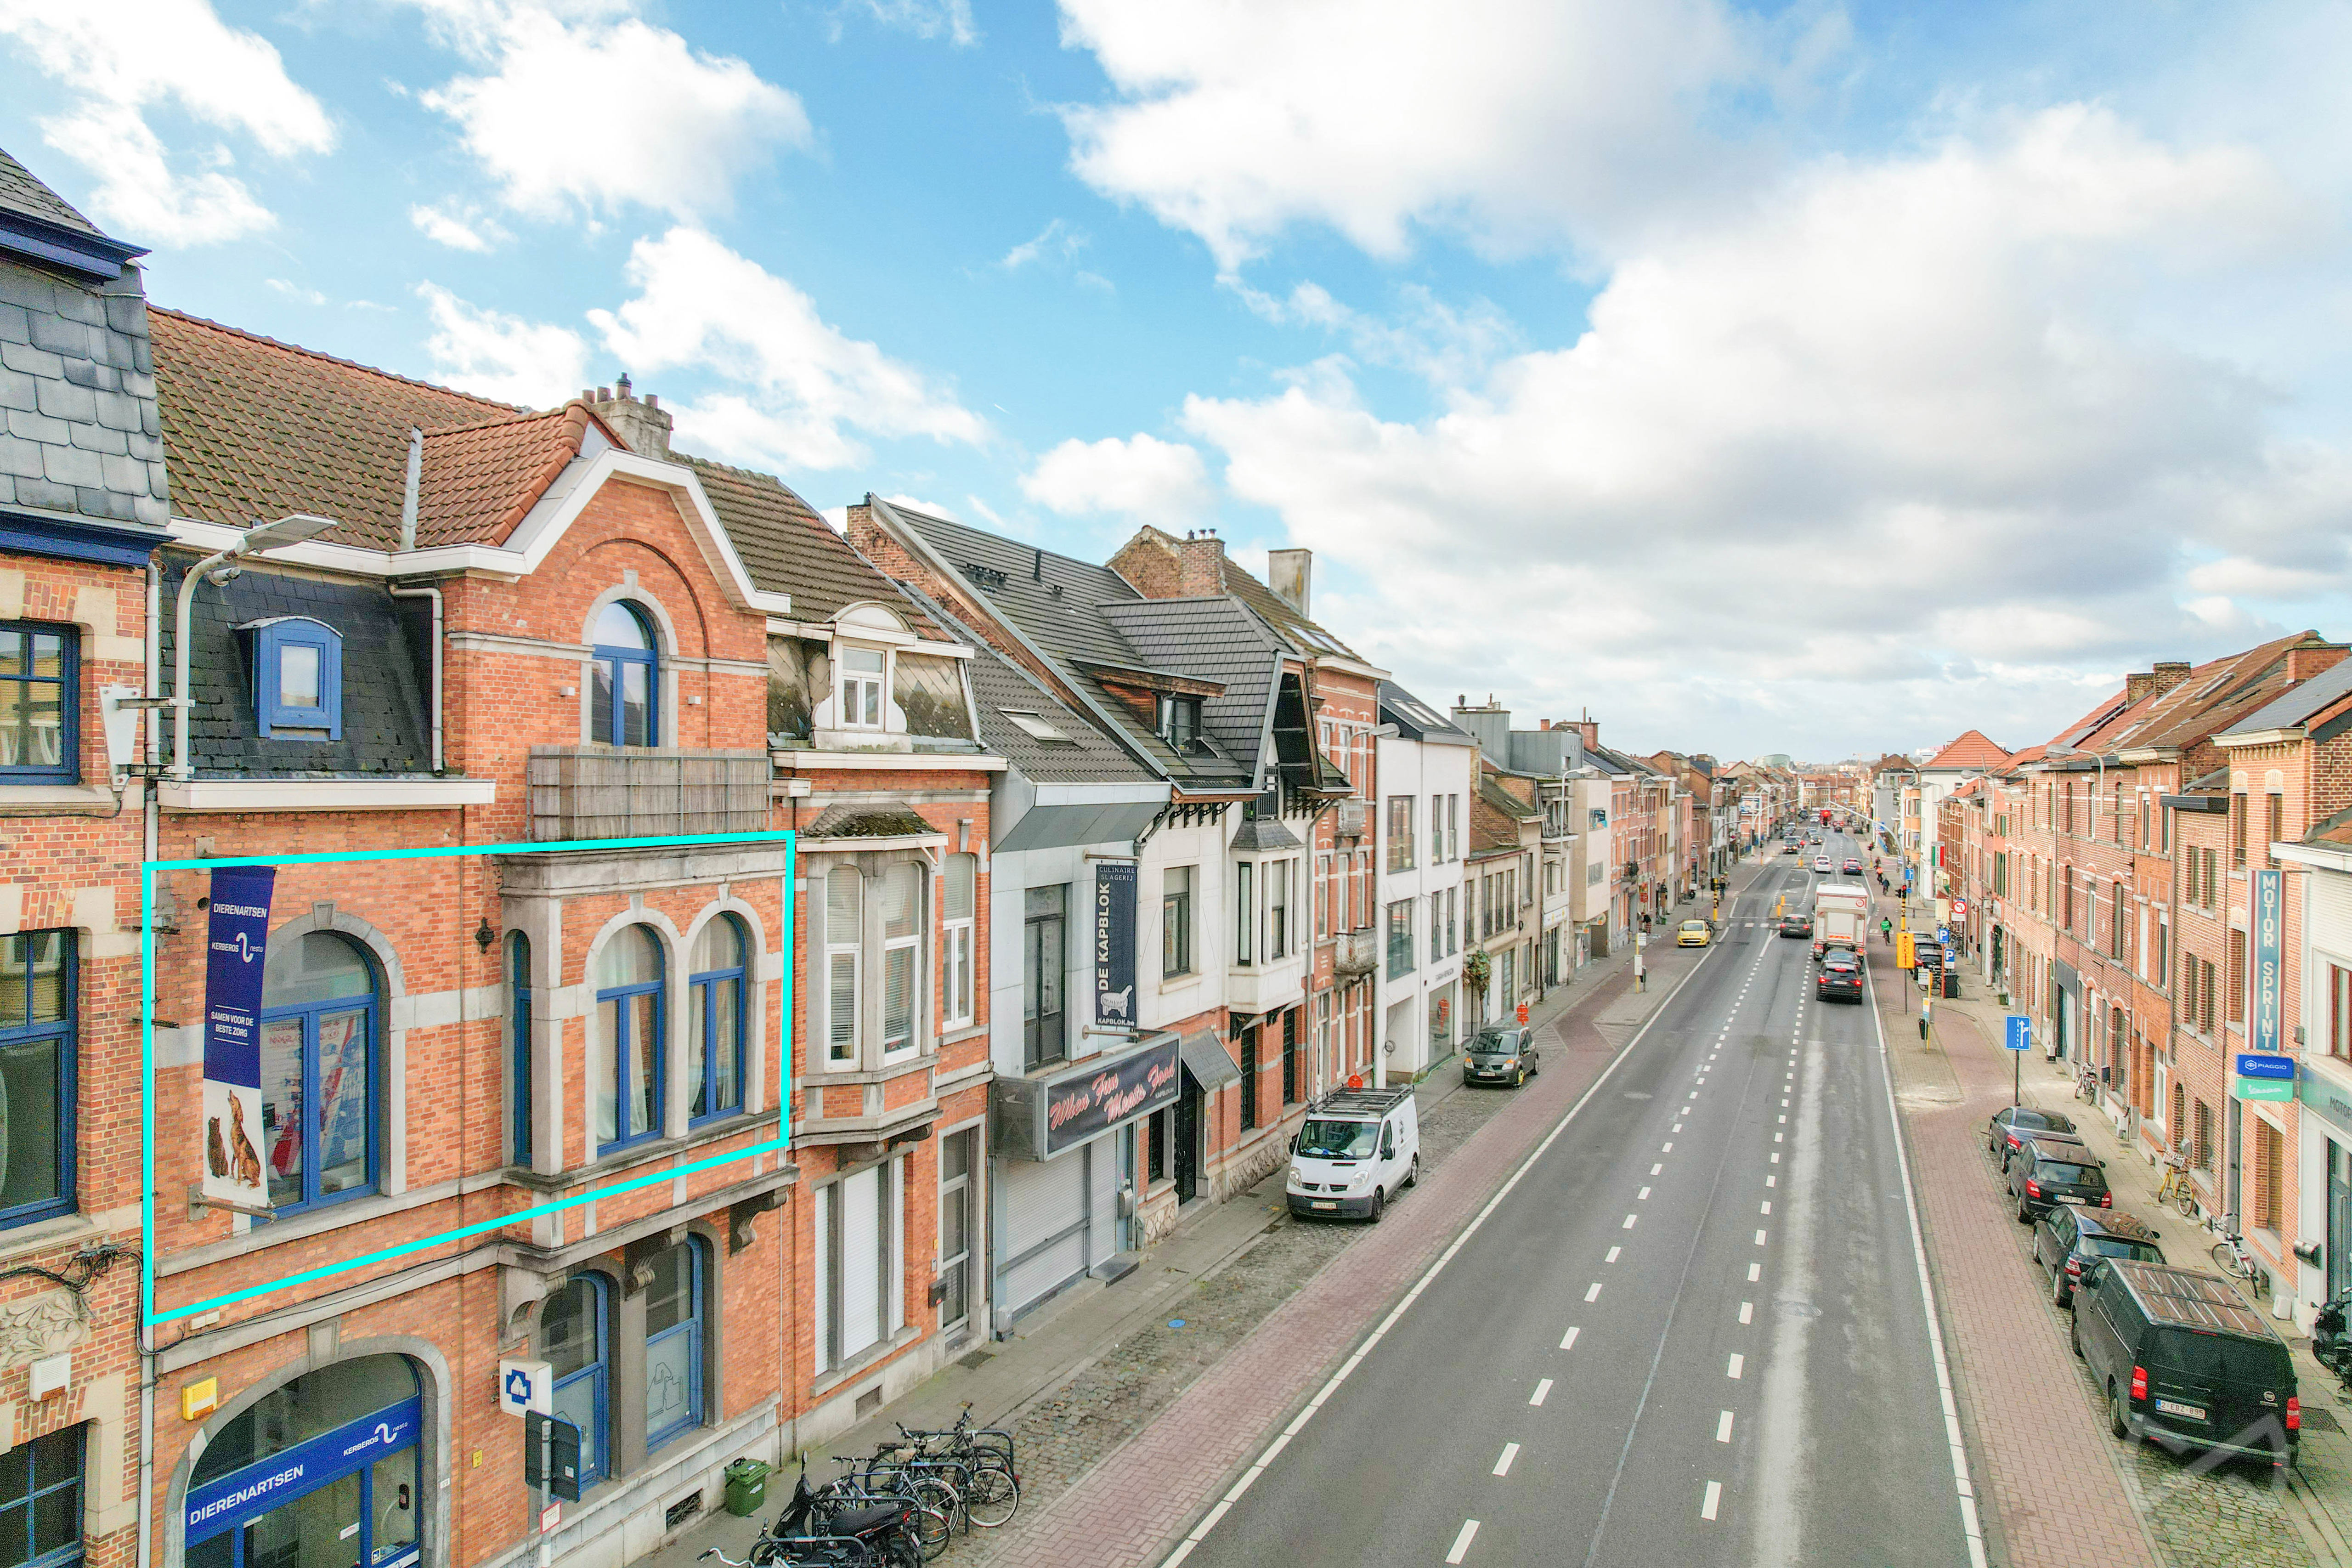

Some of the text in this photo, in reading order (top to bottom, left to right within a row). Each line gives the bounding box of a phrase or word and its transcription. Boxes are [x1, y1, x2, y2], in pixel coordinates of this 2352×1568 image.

[214, 903, 267, 918] DIERENARTSEN
[1099, 883, 1110, 991] DE KAPBLOK
[1940, 930, 1948, 940] P
[212, 942, 239, 952] KERBEROS
[1946, 951, 1954, 960] P
[2262, 875, 2276, 1048] MOTOR SPRINT
[211, 1011, 254, 1026] SAMEN VOOR DE
[1097, 1018, 1135, 1026] KAPBLOK.be
[215, 1024, 248, 1037] BESTE ZORG
[1049, 1054, 1175, 1131] When Fun Meats Food
[343, 1421, 408, 1456] KERBEROS nesto
[190, 1464, 303, 1525] DIERENARTSEN
